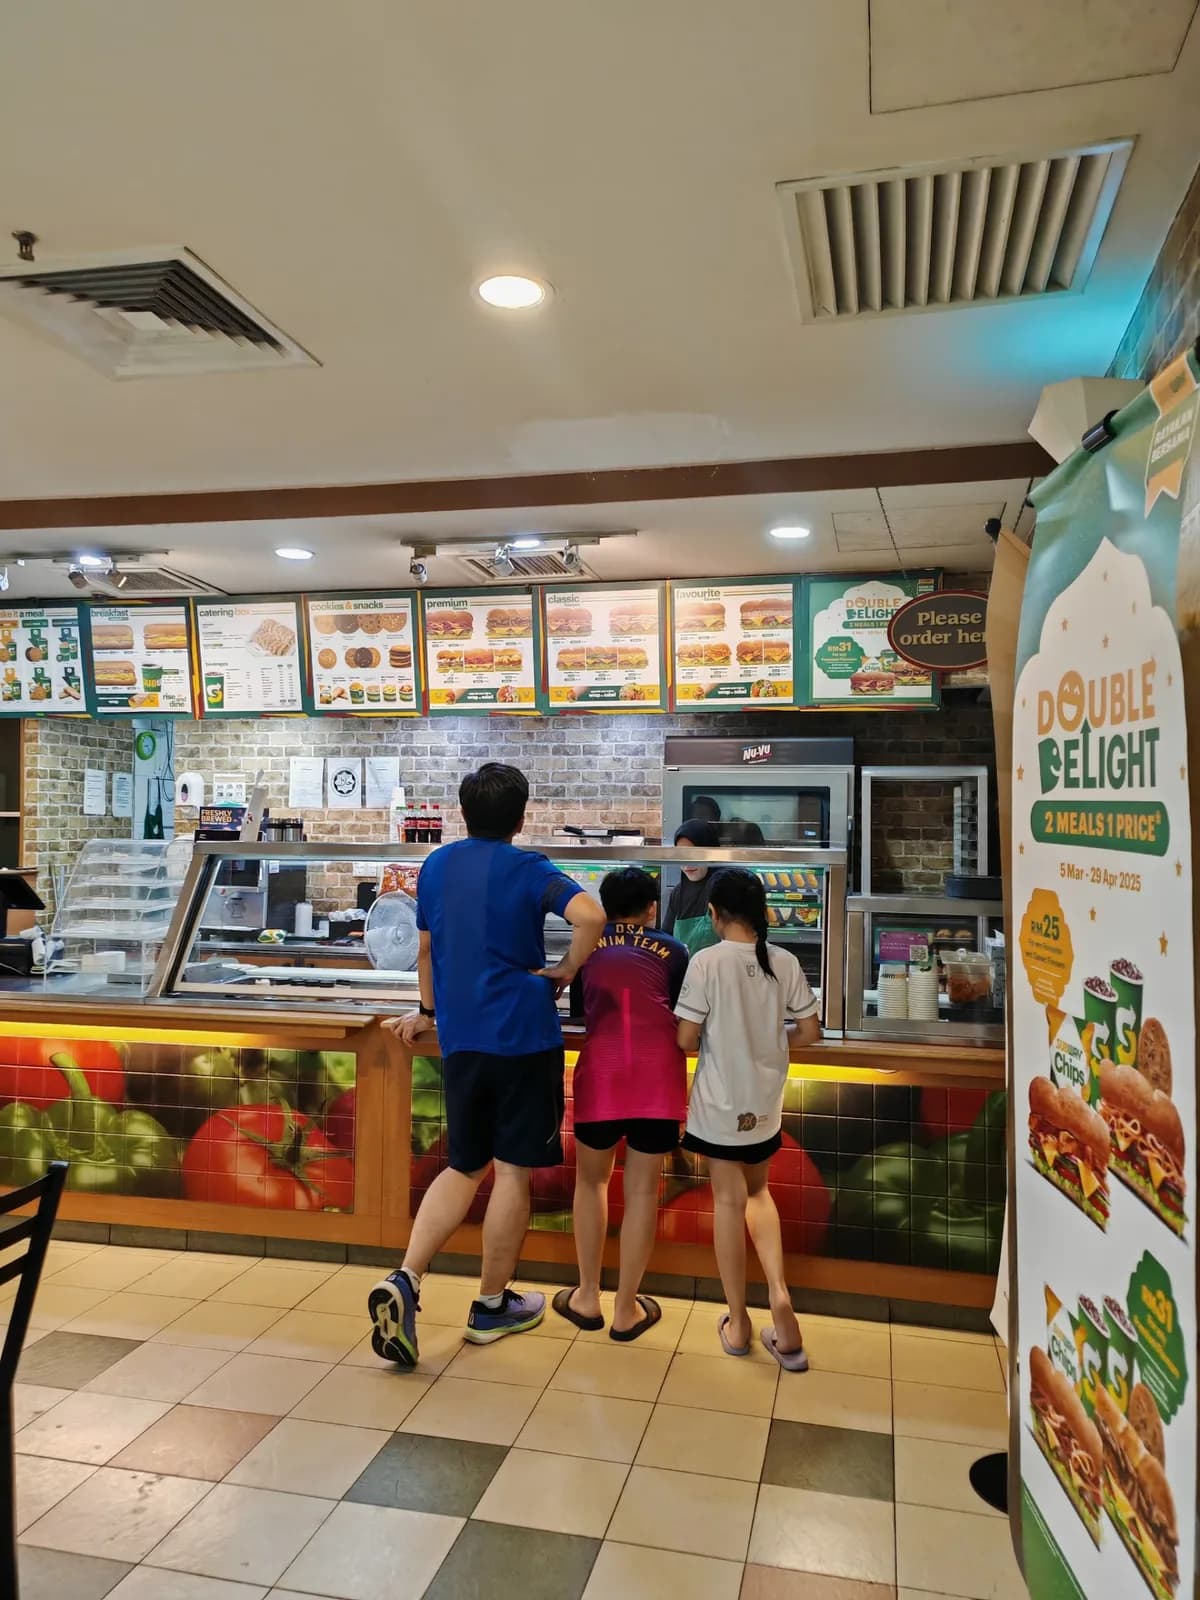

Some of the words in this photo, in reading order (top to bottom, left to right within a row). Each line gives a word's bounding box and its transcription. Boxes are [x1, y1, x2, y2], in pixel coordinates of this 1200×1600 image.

[547, 594, 580, 604] classic
[676, 588, 721, 599] favourite
[311, 602, 344, 610] cookies
[345, 602, 352, 610] &
[353, 600, 383, 610] snacks
[427, 599, 468, 610] premium
[846, 596, 901, 608] DOUBLE
[91, 608, 129, 617] breakfast
[200, 607, 234, 617] catering
[846, 606, 898, 620] DELIGH
[917, 611, 982, 626] Please
[900, 629, 952, 646] order
[957, 628, 988, 644] her
[1038, 659, 1157, 736] DOUBLE
[1038, 726, 1160, 795] DELIGHT
[201, 809, 233, 817] FRESHLY
[201, 815, 232, 823] BREWED
[1044, 811, 1054, 833] 2
[1056, 812, 1105, 837] MEALS
[1107, 813, 1114, 837] 1
[1060, 863, 1066, 878] 5
[1067, 864, 1084, 880] Mar
[1090, 867, 1101, 884] 29
[1103, 869, 1118, 889] Apr
[1119, 872, 1142, 892] 2025
[1031, 913, 1060, 941] RM25
[593, 935, 625, 951] WIM
[633, 935, 670, 959] TEAM
[1054, 1051, 1086, 1087] Chips
